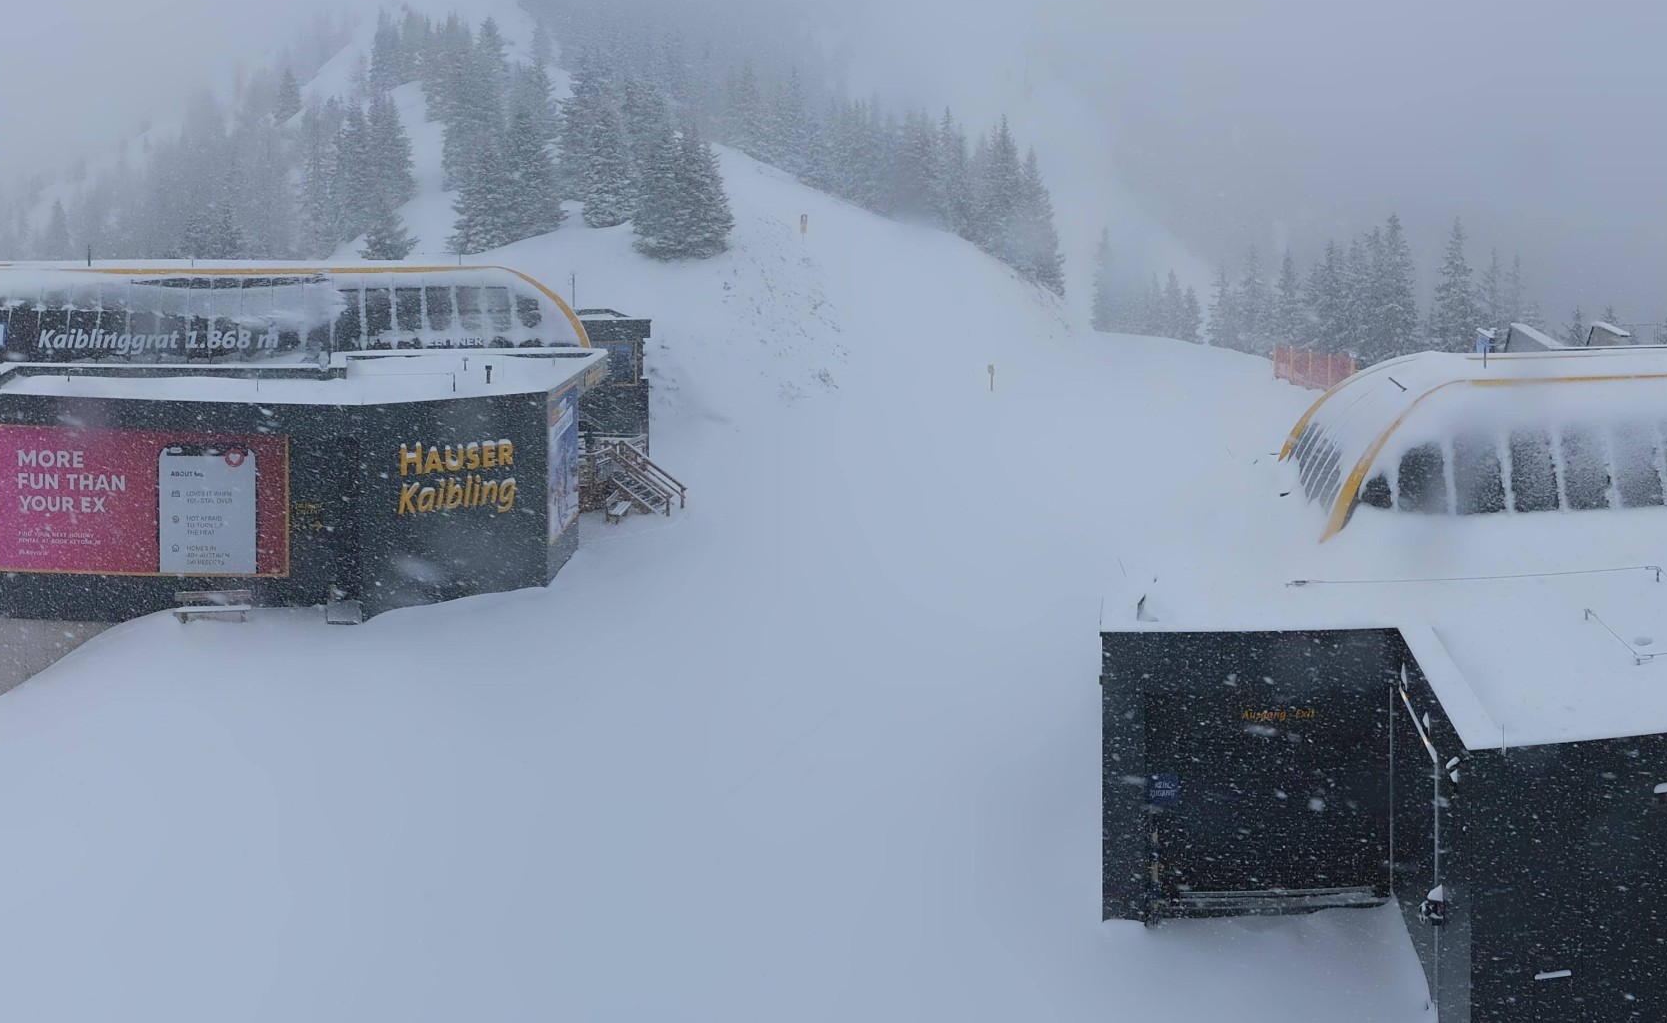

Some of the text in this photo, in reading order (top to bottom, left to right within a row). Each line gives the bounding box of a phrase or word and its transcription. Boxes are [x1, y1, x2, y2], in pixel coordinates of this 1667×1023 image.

[38, 329, 280, 354] Kaiblinggrat 1.868 m
[17, 449, 84, 468] MORE
[400, 438, 514, 475] HAUSER
[17, 473, 126, 491] FUN THAN
[398, 475, 516, 514] Kaibling
[20, 496, 106, 513] YOUR EX
[1242, 707, 1315, 722] Ausgang Exit
